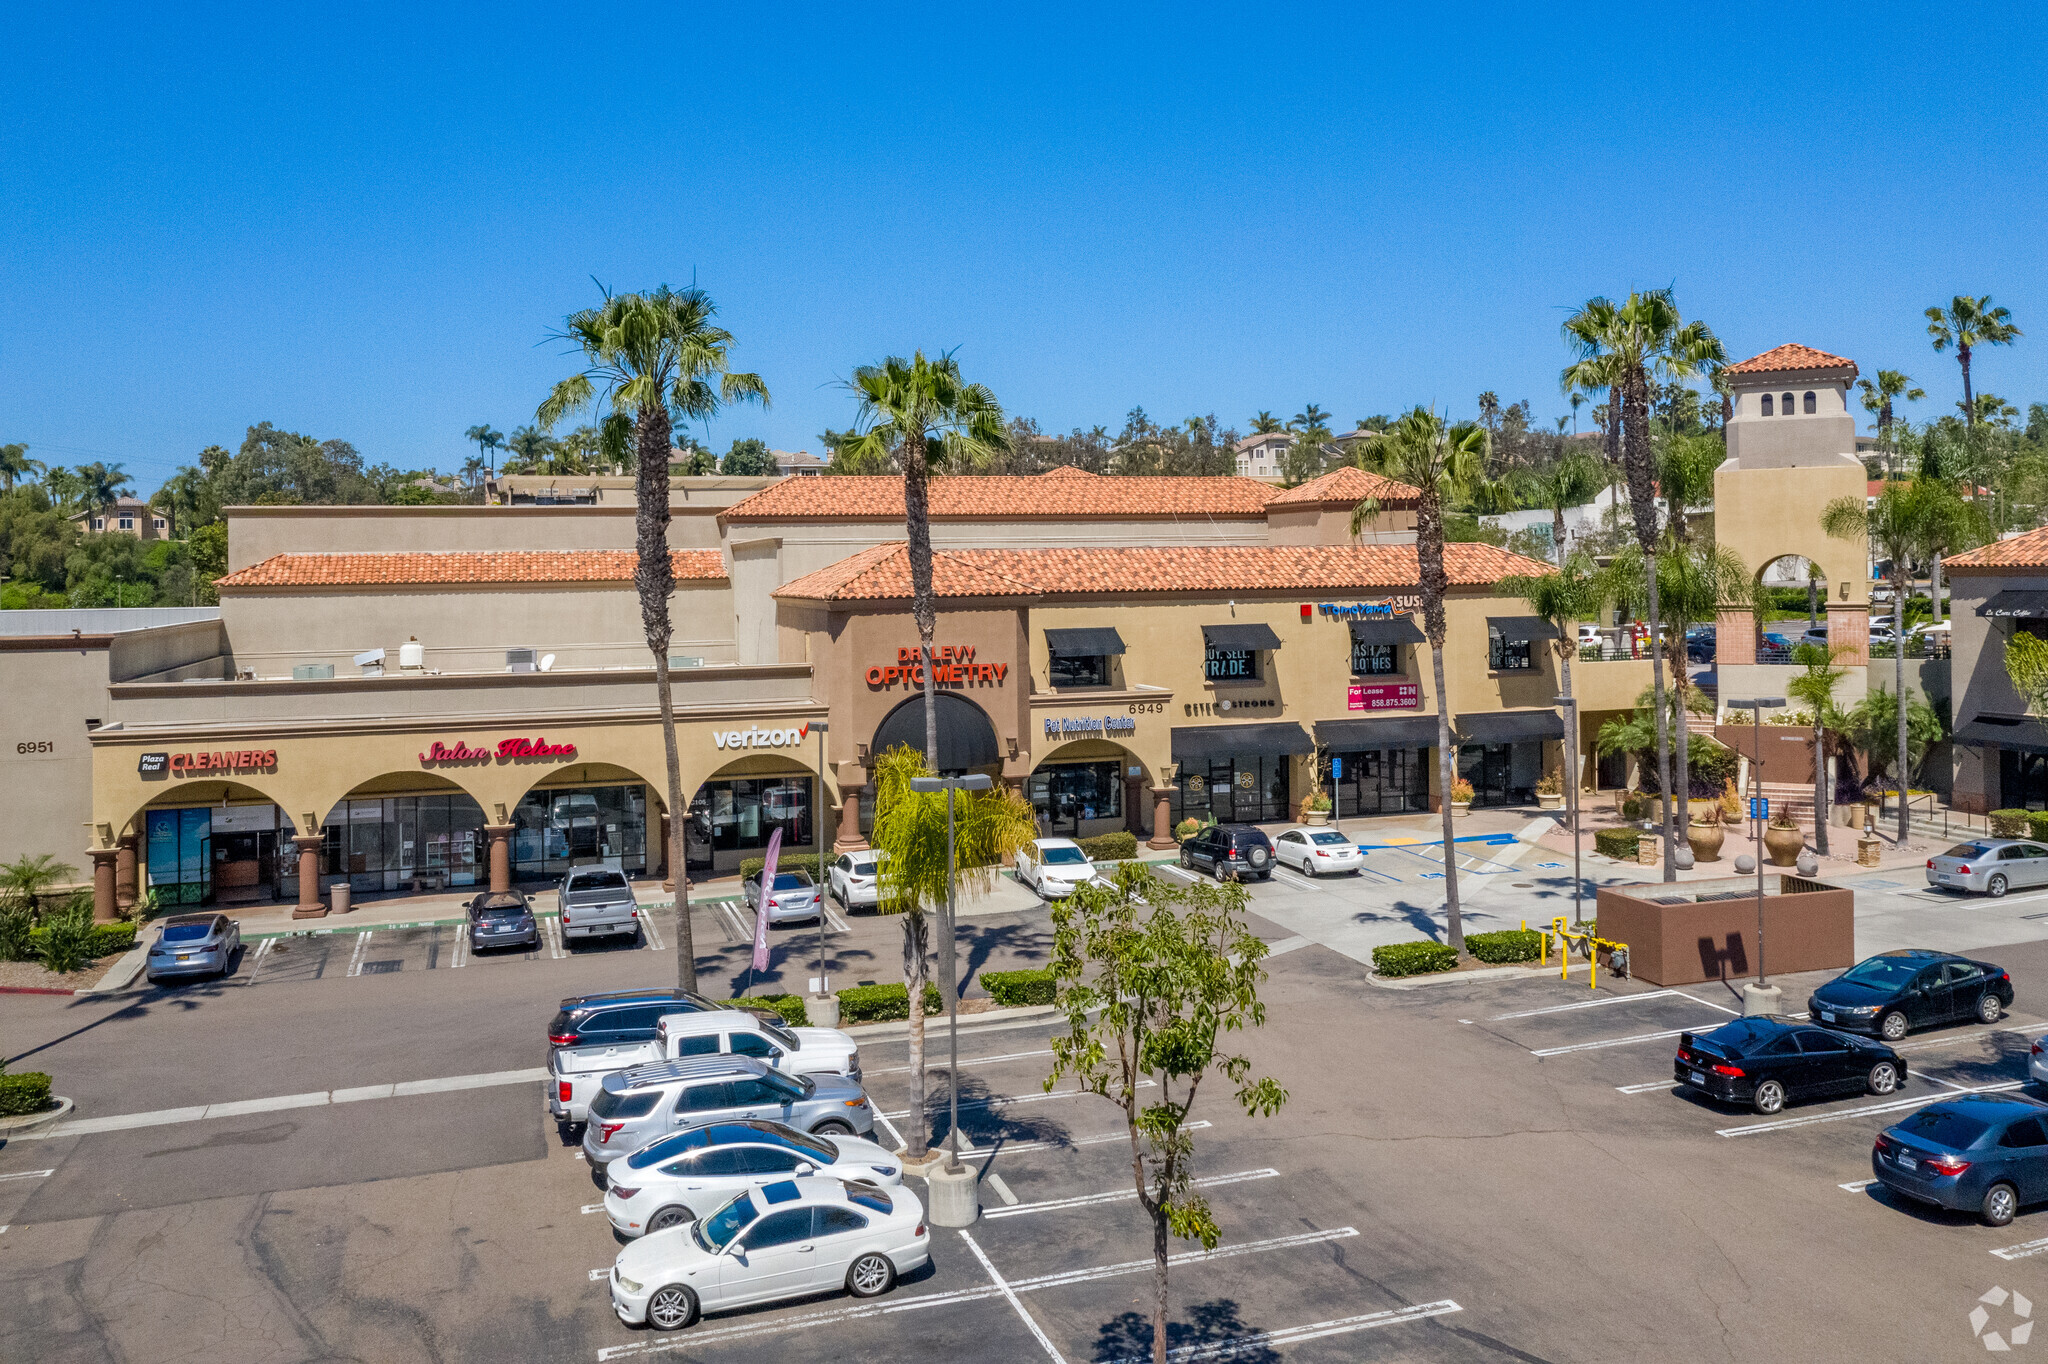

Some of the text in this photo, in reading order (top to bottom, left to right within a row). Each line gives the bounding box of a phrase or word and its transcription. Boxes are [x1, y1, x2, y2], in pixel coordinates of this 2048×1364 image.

[1318, 603, 1392, 615] TomoYama
[931, 645, 975, 660] LEVY
[1353, 643, 1374, 657] ASH
[1204, 659, 1250, 676] TRADE.
[1353, 656, 1391, 670] LOTHES
[865, 663, 1007, 684] OPTOMETRY
[1362, 687, 1384, 695] Lease
[1129, 703, 1164, 715] 6949
[1231, 699, 1275, 708] STRONG
[1371, 698, 1416, 707] 858.875.3600
[1043, 714, 1135, 733] Pet Nutrition Center
[713, 724, 800, 748] verizon
[16, 741, 53, 754] 6951
[418, 737, 577, 762] Salon Helene
[142, 755, 165, 763] Plaza
[169, 750, 276, 770] CLEANERS
[142, 763, 160, 771] Real
